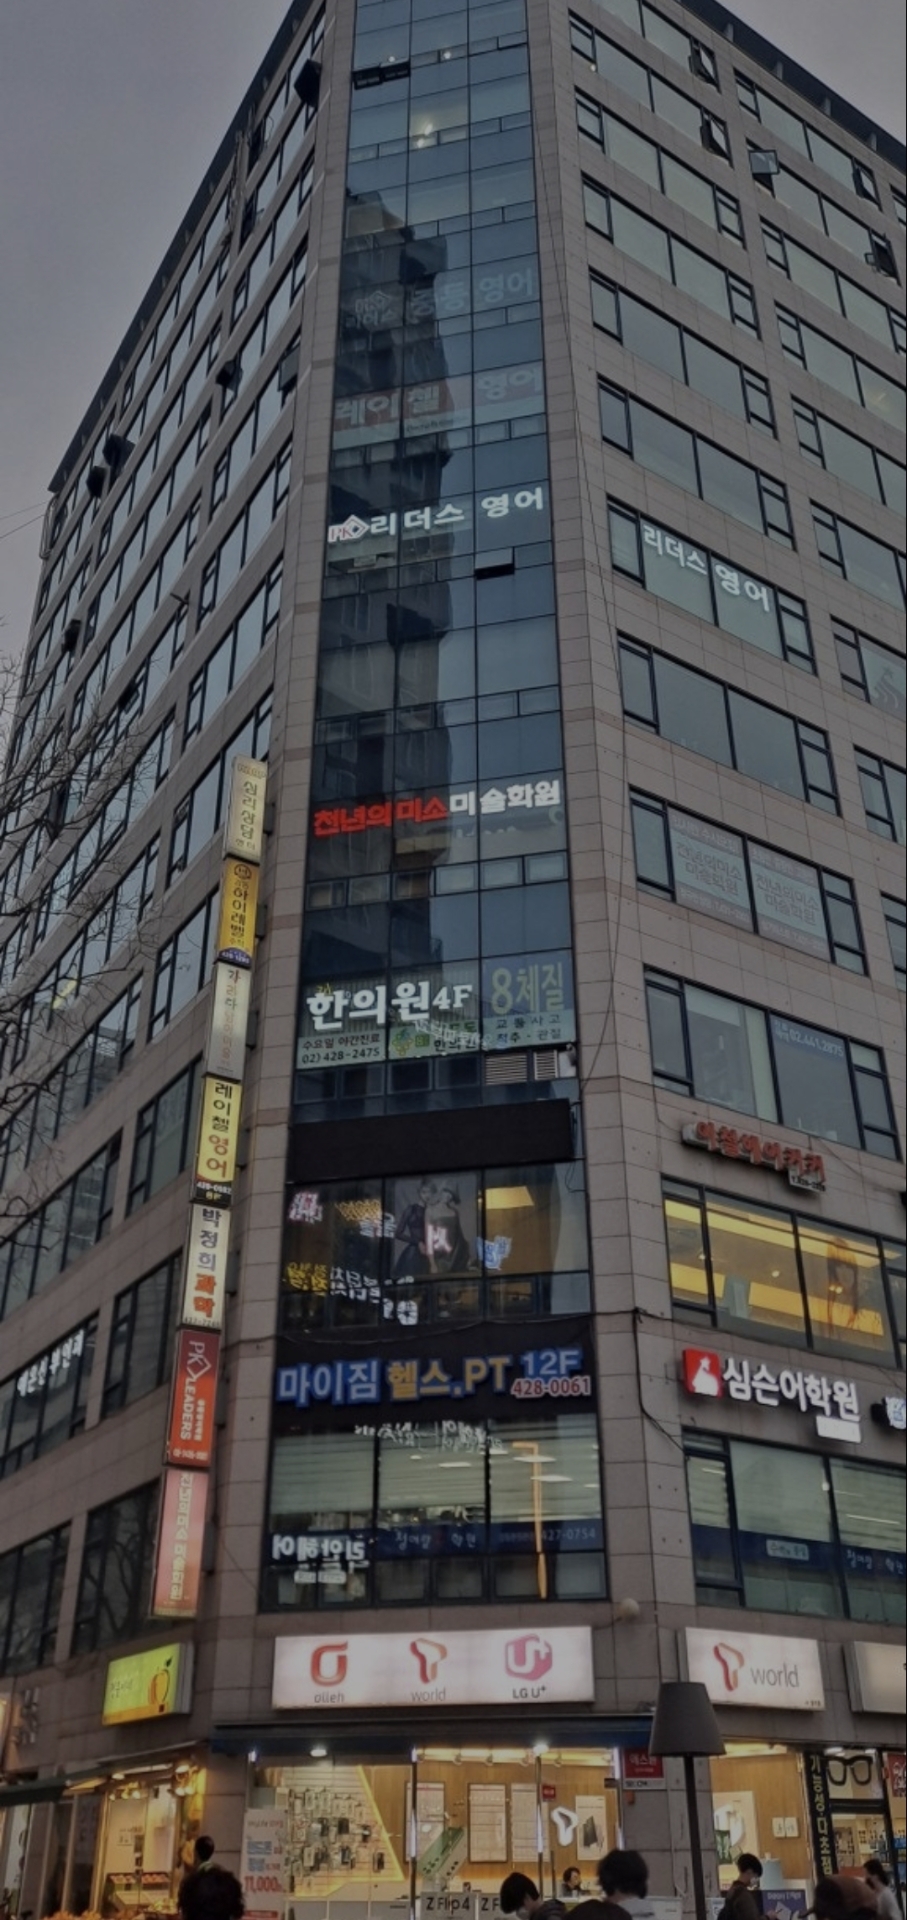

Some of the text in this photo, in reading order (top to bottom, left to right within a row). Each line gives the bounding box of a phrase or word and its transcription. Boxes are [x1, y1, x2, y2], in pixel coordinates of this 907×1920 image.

[479, 268, 534, 304] 영어
[335, 385, 439, 426] 레이첼
[476, 367, 542, 401] 영어
[370, 486, 544, 536] 리더스 영어
[642, 523, 771, 611] 리더스 영어
[450, 779, 561, 817] 미술학원
[492, 963, 564, 1013] 8체질
[212, 1082, 234, 1134] 레이첼
[206, 1134, 230, 1178] 영어
[198, 1207, 222, 1272] 박정희
[277, 1359, 380, 1407] 마이짐
[521, 1348, 582, 1377] 12F
[510, 1376, 592, 1398] 428-0061
[722, 1356, 861, 1422] 심슨어학원
[180, 1378, 198, 1441] LEADERS
[314, 1691, 345, 1704] olleh
[411, 1687, 447, 1703] world
[512, 1687, 528, 1699] LG
[750, 1662, 800, 1689] world
[426, 1897, 436, 1911] Z
[481, 1897, 490, 1911] Z
